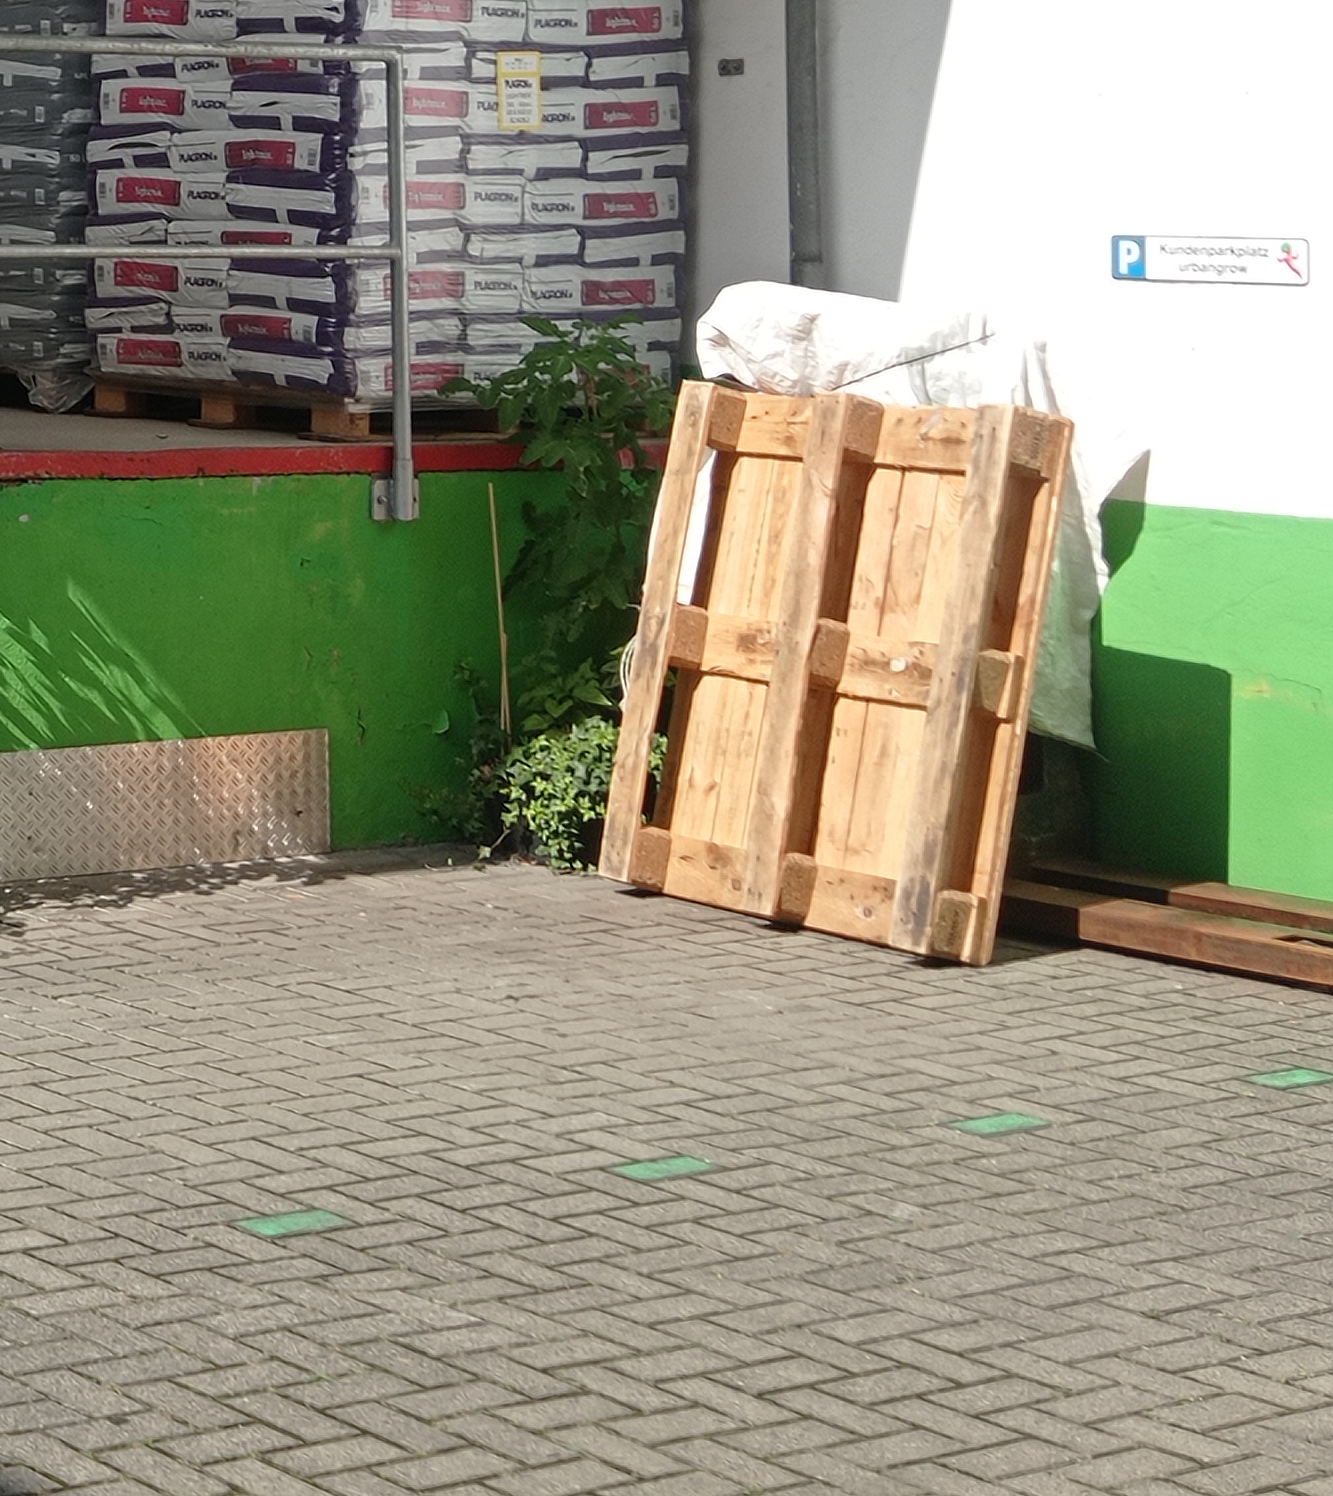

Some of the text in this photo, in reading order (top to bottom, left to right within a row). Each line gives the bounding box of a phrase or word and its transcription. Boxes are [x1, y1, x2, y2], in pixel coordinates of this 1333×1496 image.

[481, 6, 521, 18] PLAGRON
[534, 18, 574, 29] PLAGRON
[181, 61, 215, 72] PLAGRON
[179, 153, 213, 164] PLAGRON
[187, 191, 221, 201] PLAGRON
[474, 192, 514, 202] PLAGRON
[531, 202, 571, 213] PLAGRON
[1118, 239, 1140, 274] P
[1159, 243, 1269, 259] Kundenparkplatz
[1179, 263, 1248, 276] urbangrow
[474, 280, 513, 290] PLAGRON
